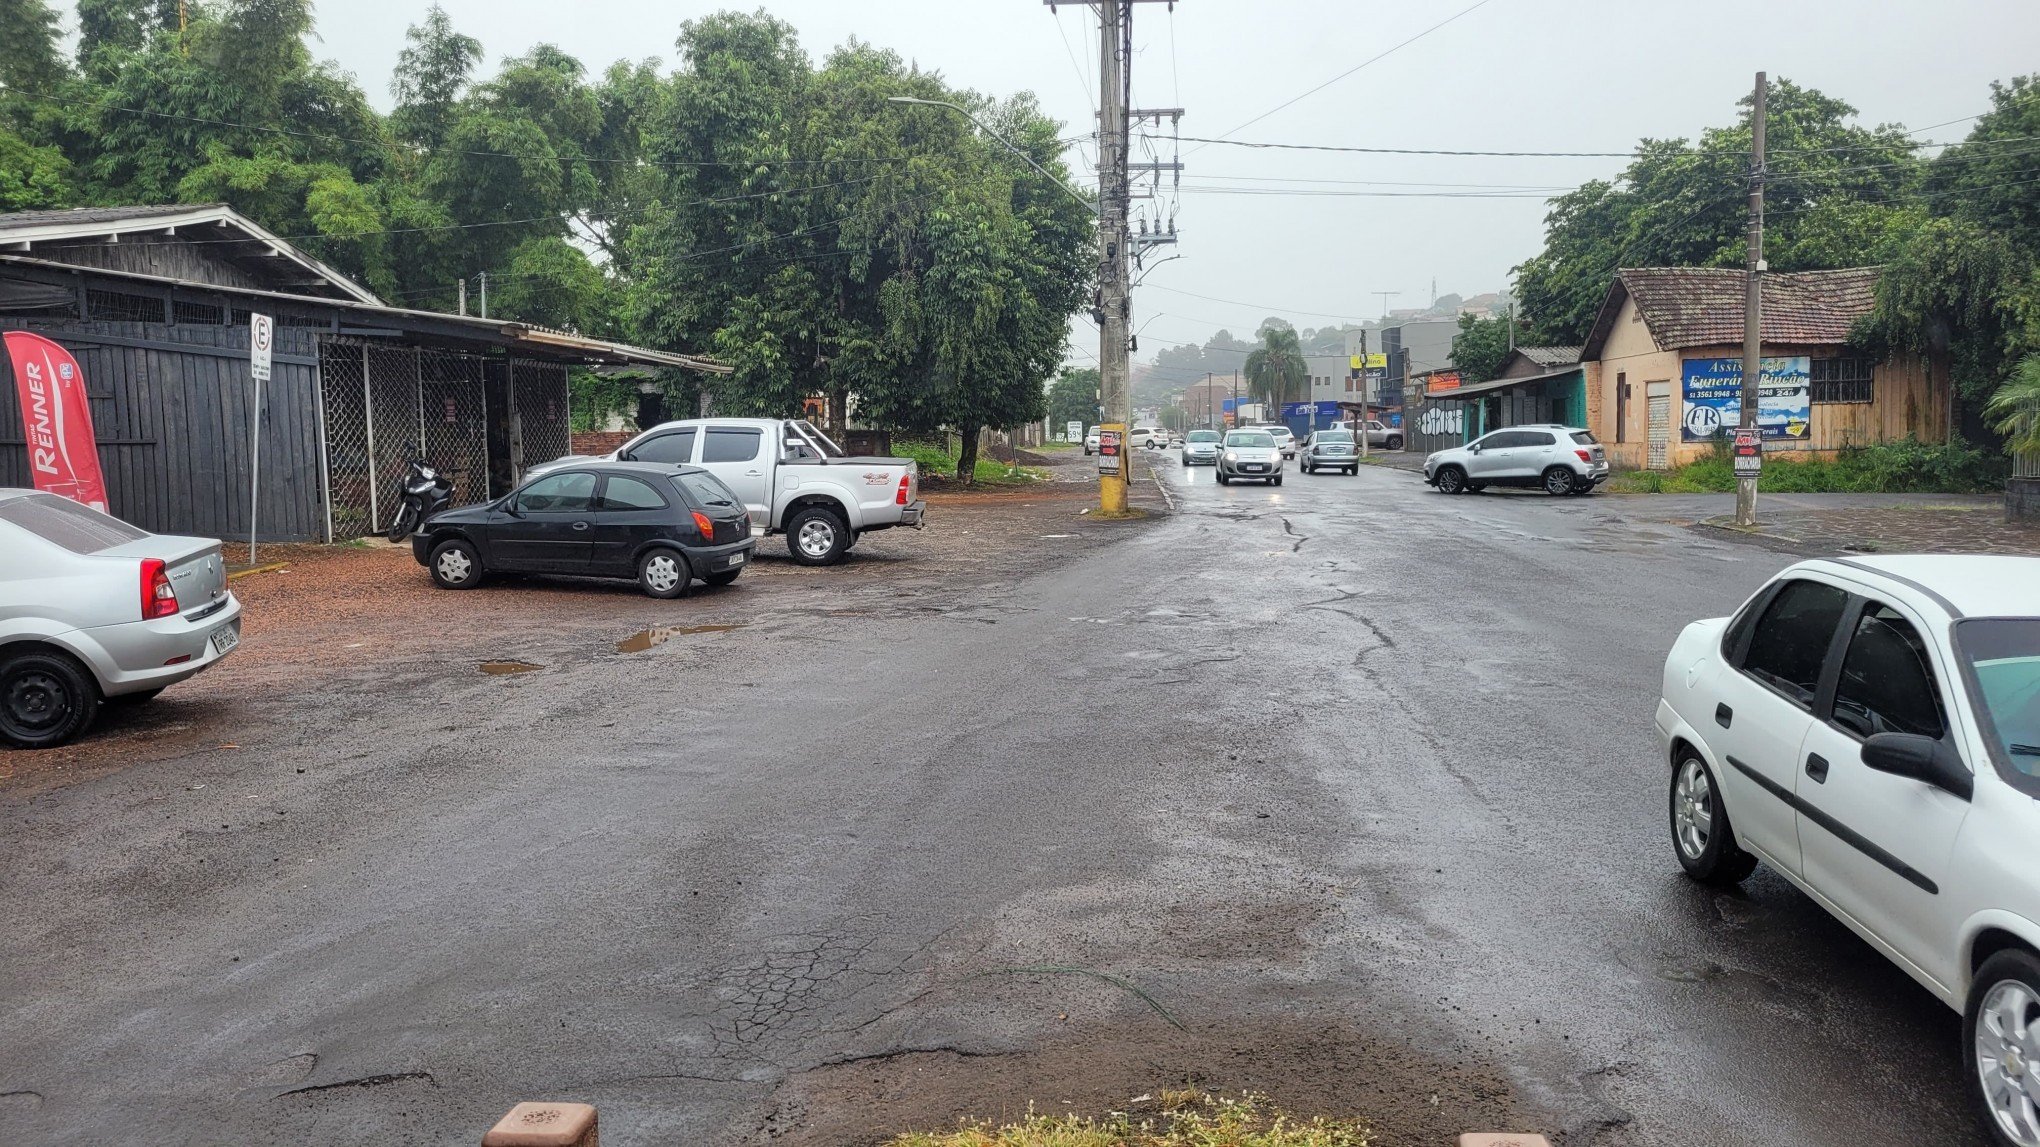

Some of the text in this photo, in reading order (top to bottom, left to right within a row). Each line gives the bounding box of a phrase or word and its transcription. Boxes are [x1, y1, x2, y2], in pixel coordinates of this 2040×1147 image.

[1708, 360, 1786, 372] Assisncia
[1689, 373, 1805, 386] Funerár Rincão
[27, 362, 58, 475] RENNER
[1691, 409, 1718, 425] FR
